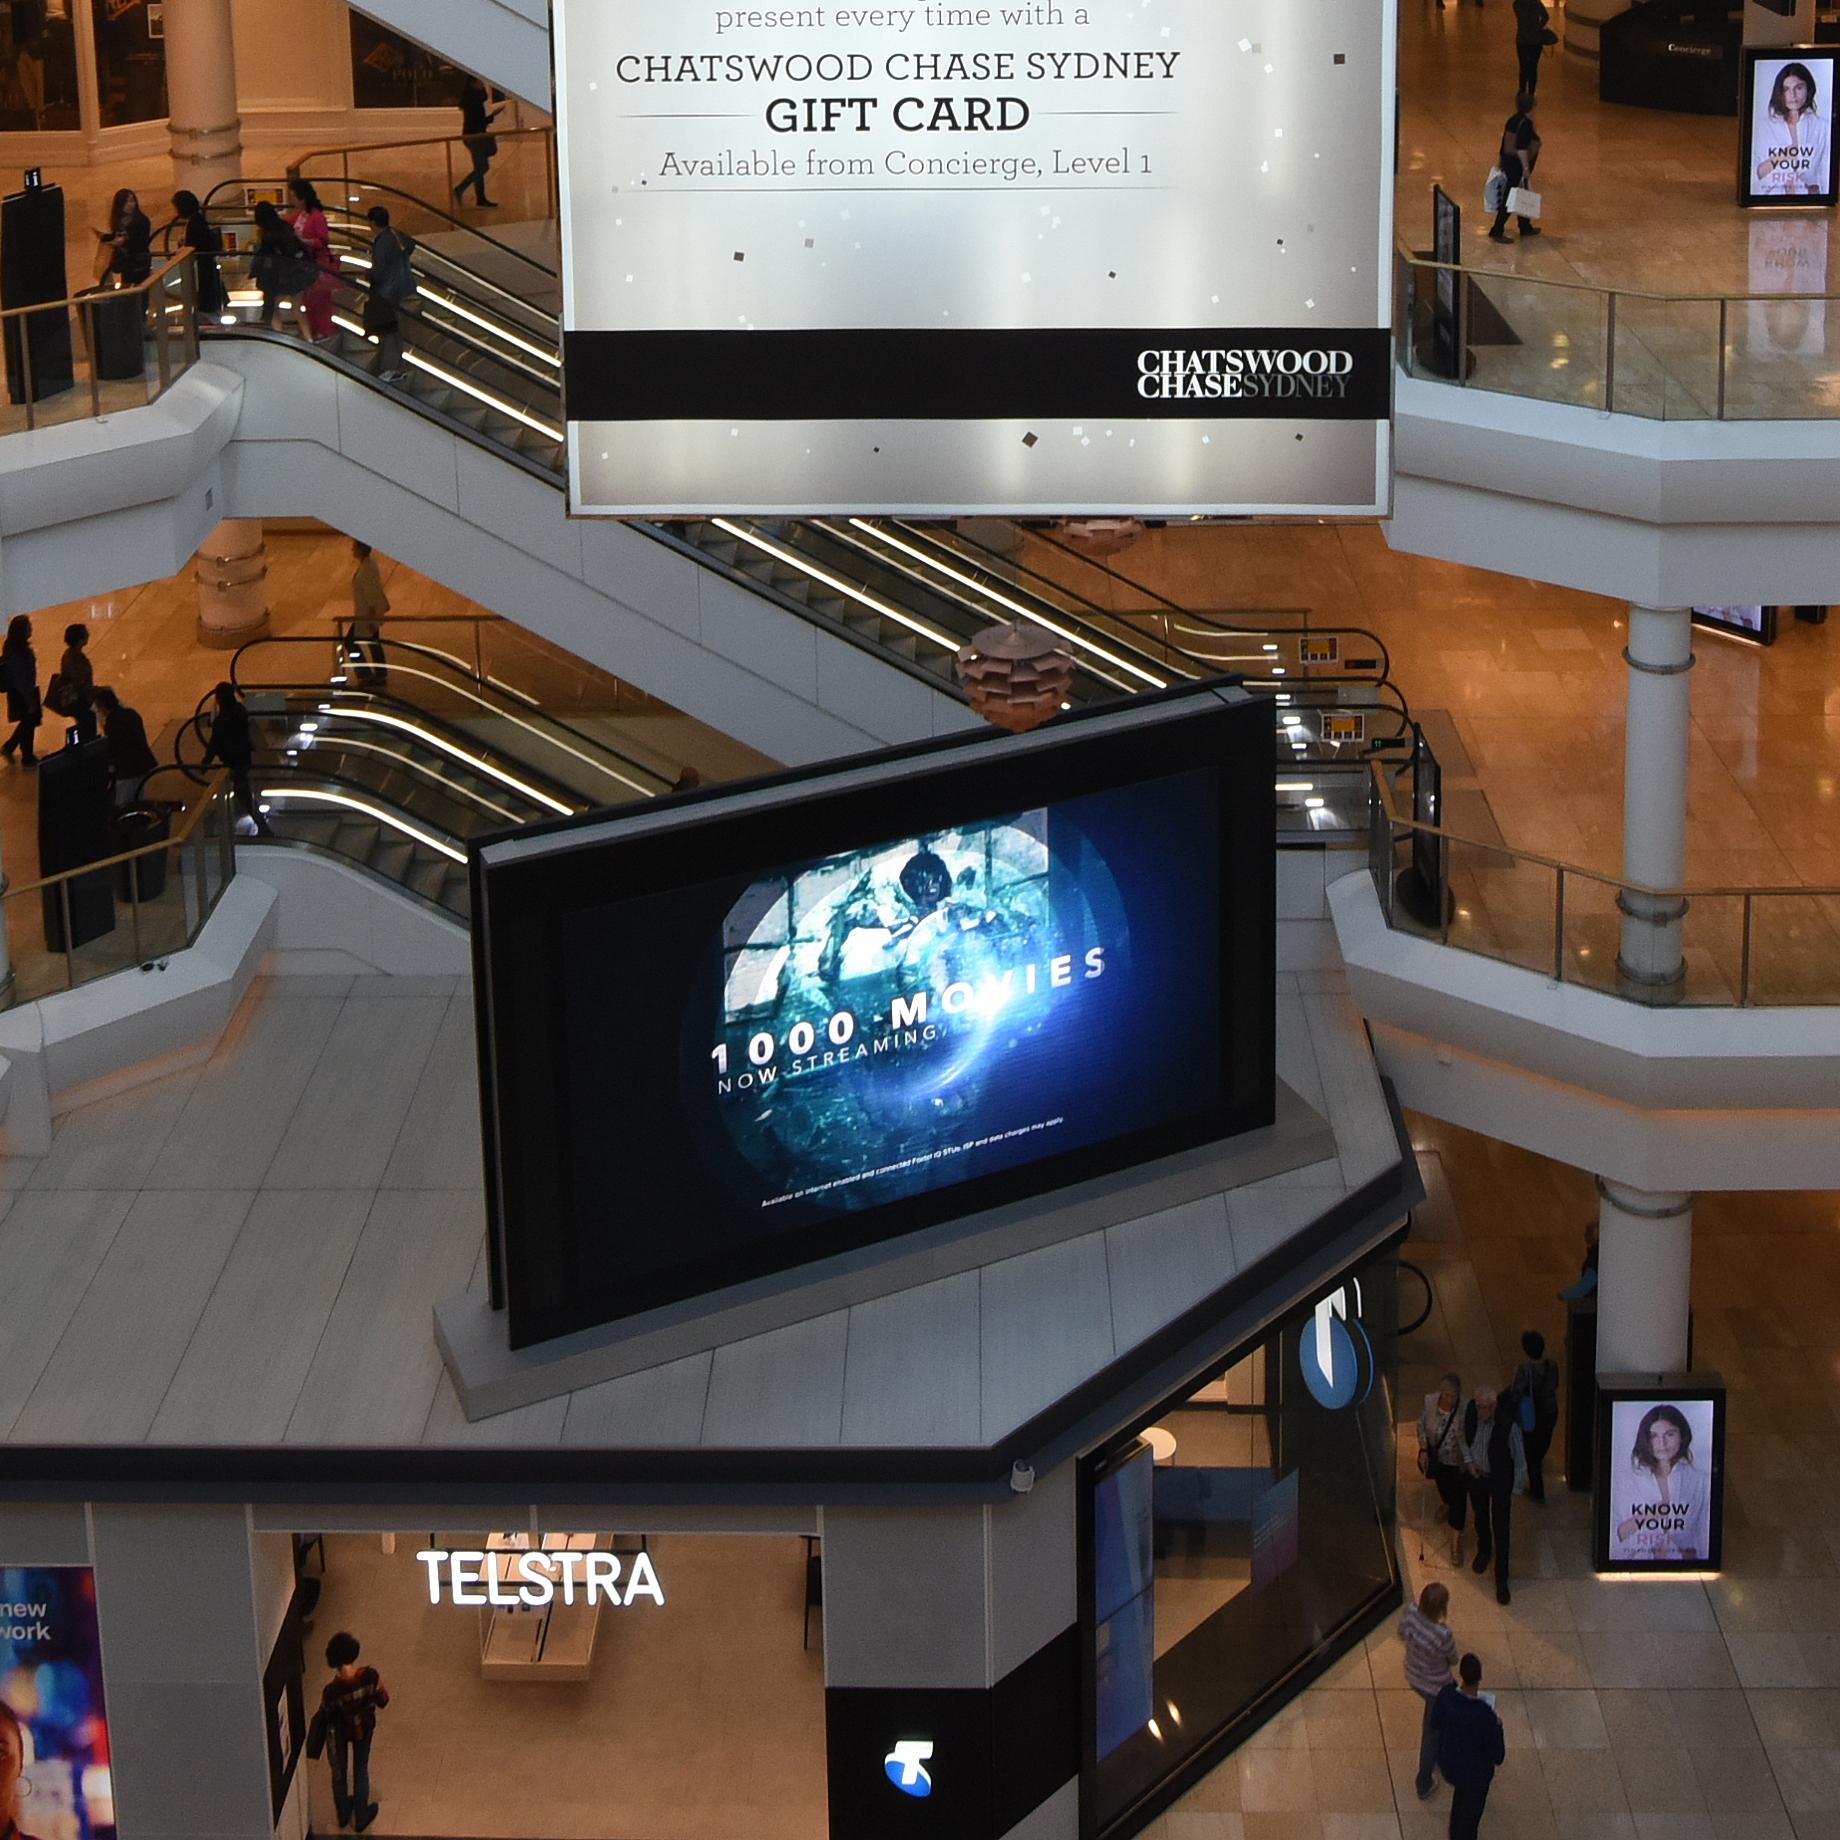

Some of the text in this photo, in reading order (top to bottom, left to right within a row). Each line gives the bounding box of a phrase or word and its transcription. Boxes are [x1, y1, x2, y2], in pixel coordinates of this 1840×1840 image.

[715, 0, 1090, 34] present every time with a
[1667, 43, 1711, 57] Concierge
[615, 50, 1181, 83] CHATSWOOD CHASE SYDNEY
[765, 96, 1031, 133] GIFT CARD
[658, 147, 1153, 181] Available from Concierge, Level 1
[1768, 146, 1814, 158] KNOW
[1770, 159, 1810, 170] YOUR
[1772, 172, 1805, 183] RISK
[1137, 349, 1353, 375] CHATSWOOD
[1137, 373, 1352, 399] CHASE SYDNEY
[711, 947, 1107, 1075] 1000 MOVIES
[717, 1024, 939, 1095] NOW STREAMING
[1631, 1503, 1690, 1516] KNOW
[1634, 1518, 1685, 1531] YOUR
[416, 1551, 665, 1606] TELSTRA
[0, 1602, 47, 1617] new
